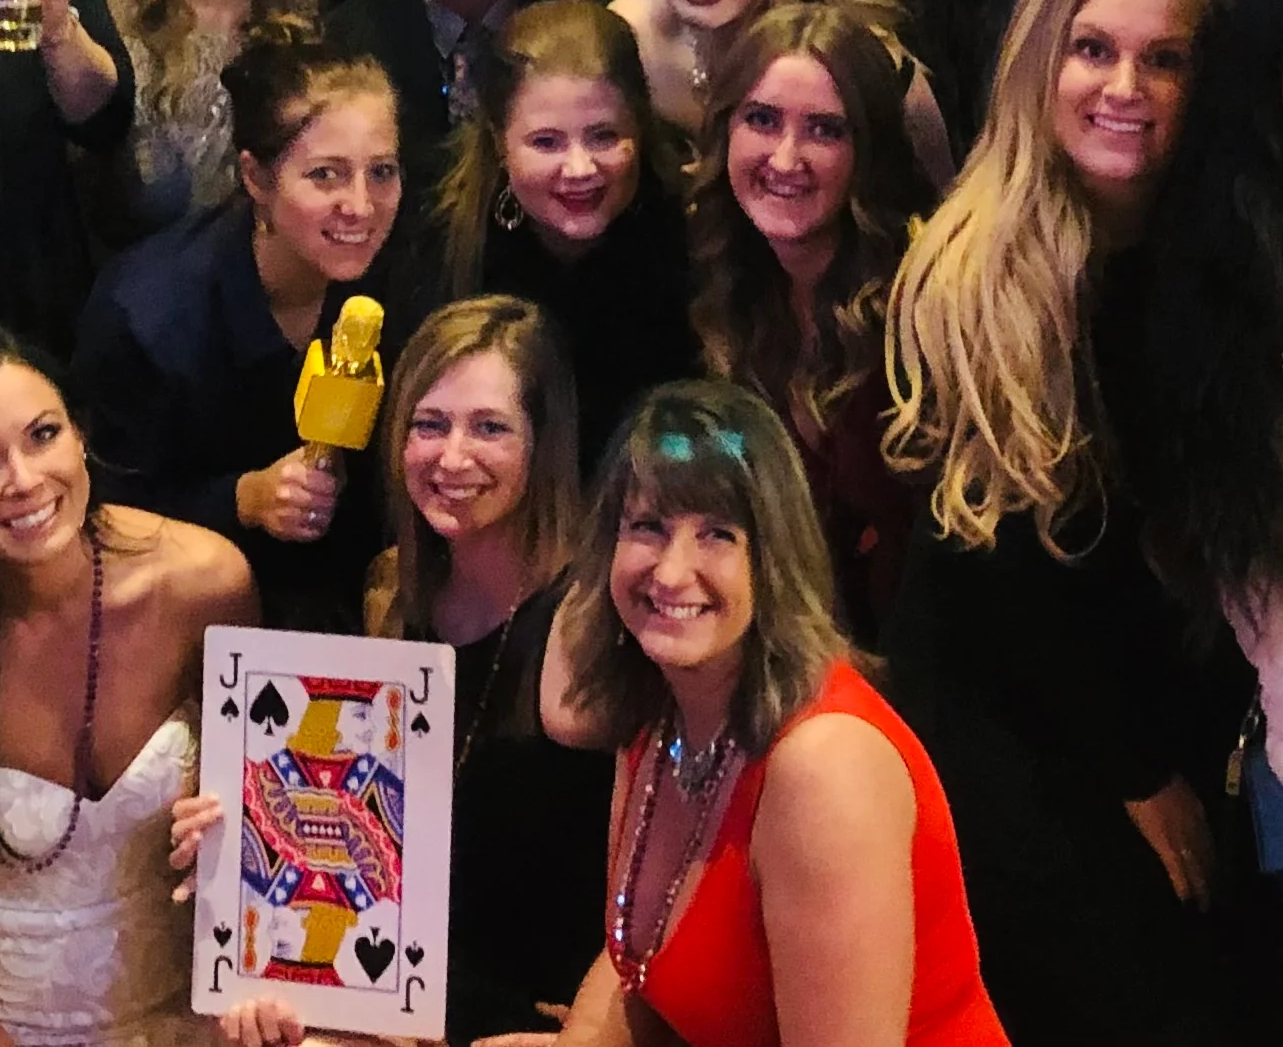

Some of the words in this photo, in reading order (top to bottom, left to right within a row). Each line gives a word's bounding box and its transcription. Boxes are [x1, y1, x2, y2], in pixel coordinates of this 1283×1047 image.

[219, 652, 243, 689] J
[409, 666, 434, 705] J
[208, 955, 234, 994] J
[400, 975, 426, 1014] J
